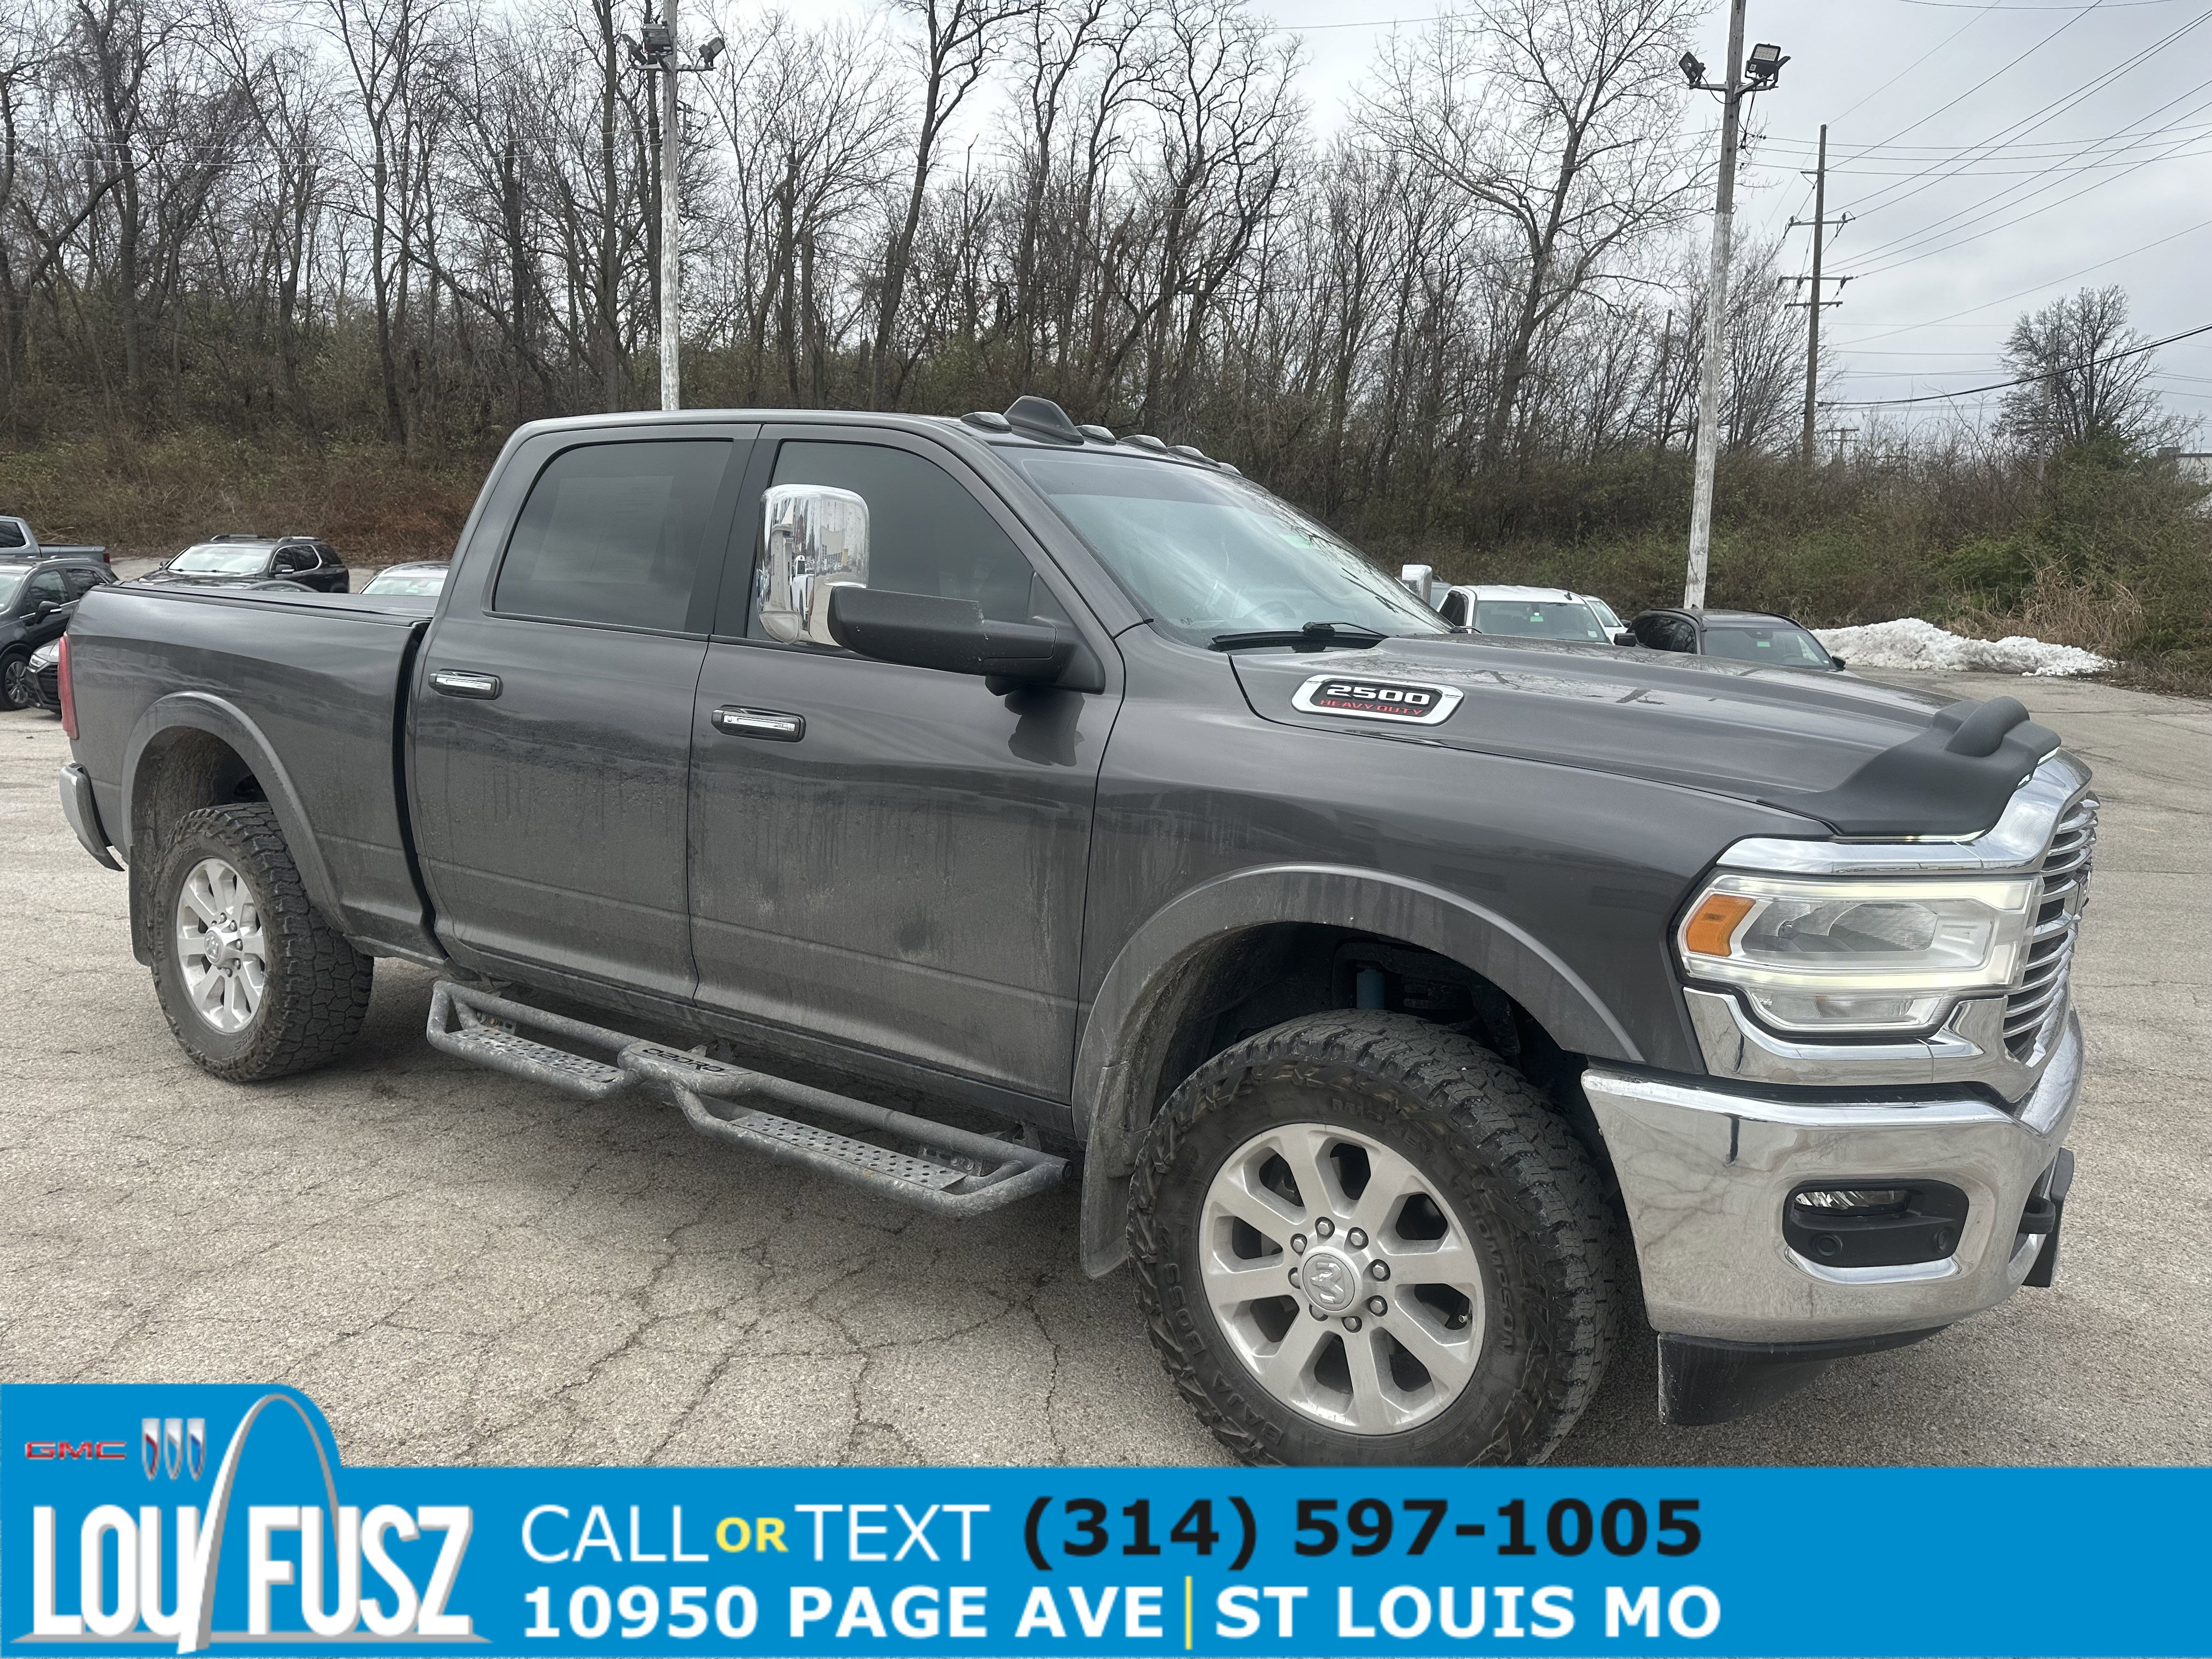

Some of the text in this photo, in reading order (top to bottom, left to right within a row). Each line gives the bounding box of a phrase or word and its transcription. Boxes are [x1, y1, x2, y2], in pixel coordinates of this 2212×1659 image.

[1320, 699, 1425, 715] HEAVY DUTY
[1327, 684, 1430, 705] 2500
[1450, 1176, 1515, 1355] THOMPSON
[1164, 1263, 1206, 1356] BOSS
[1212, 1370, 1284, 1446] BAJA
